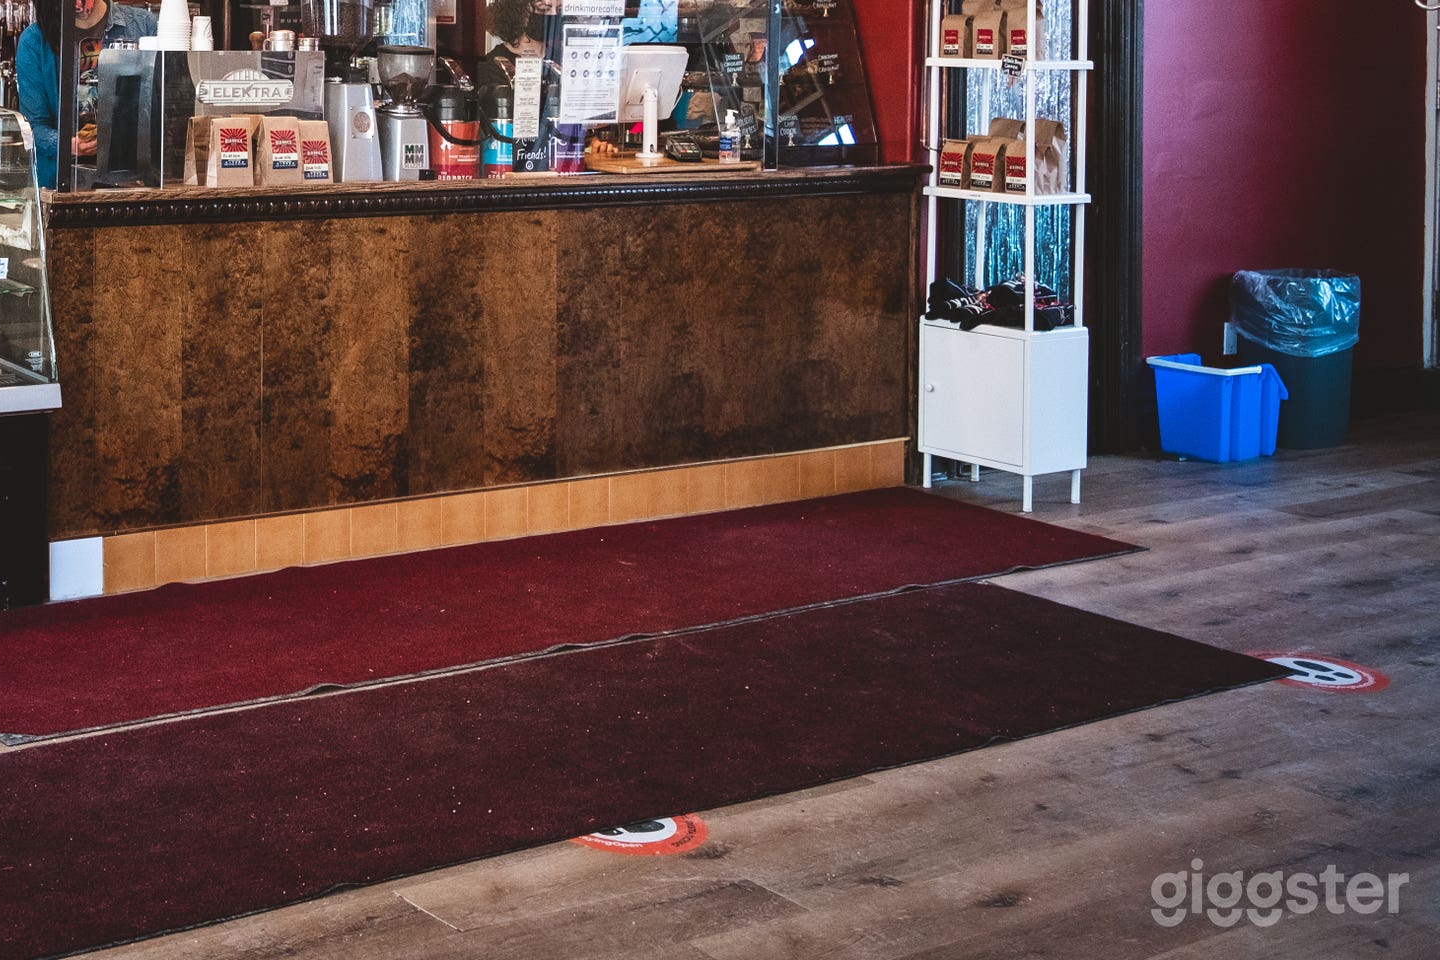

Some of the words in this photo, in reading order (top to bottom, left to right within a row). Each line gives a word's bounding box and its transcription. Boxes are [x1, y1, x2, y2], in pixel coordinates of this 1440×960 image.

[564, 3, 623, 13] drinkmorecoffee
[213, 83, 282, 98] ELEKTRA
[517, 146, 546, 160] Friends!
